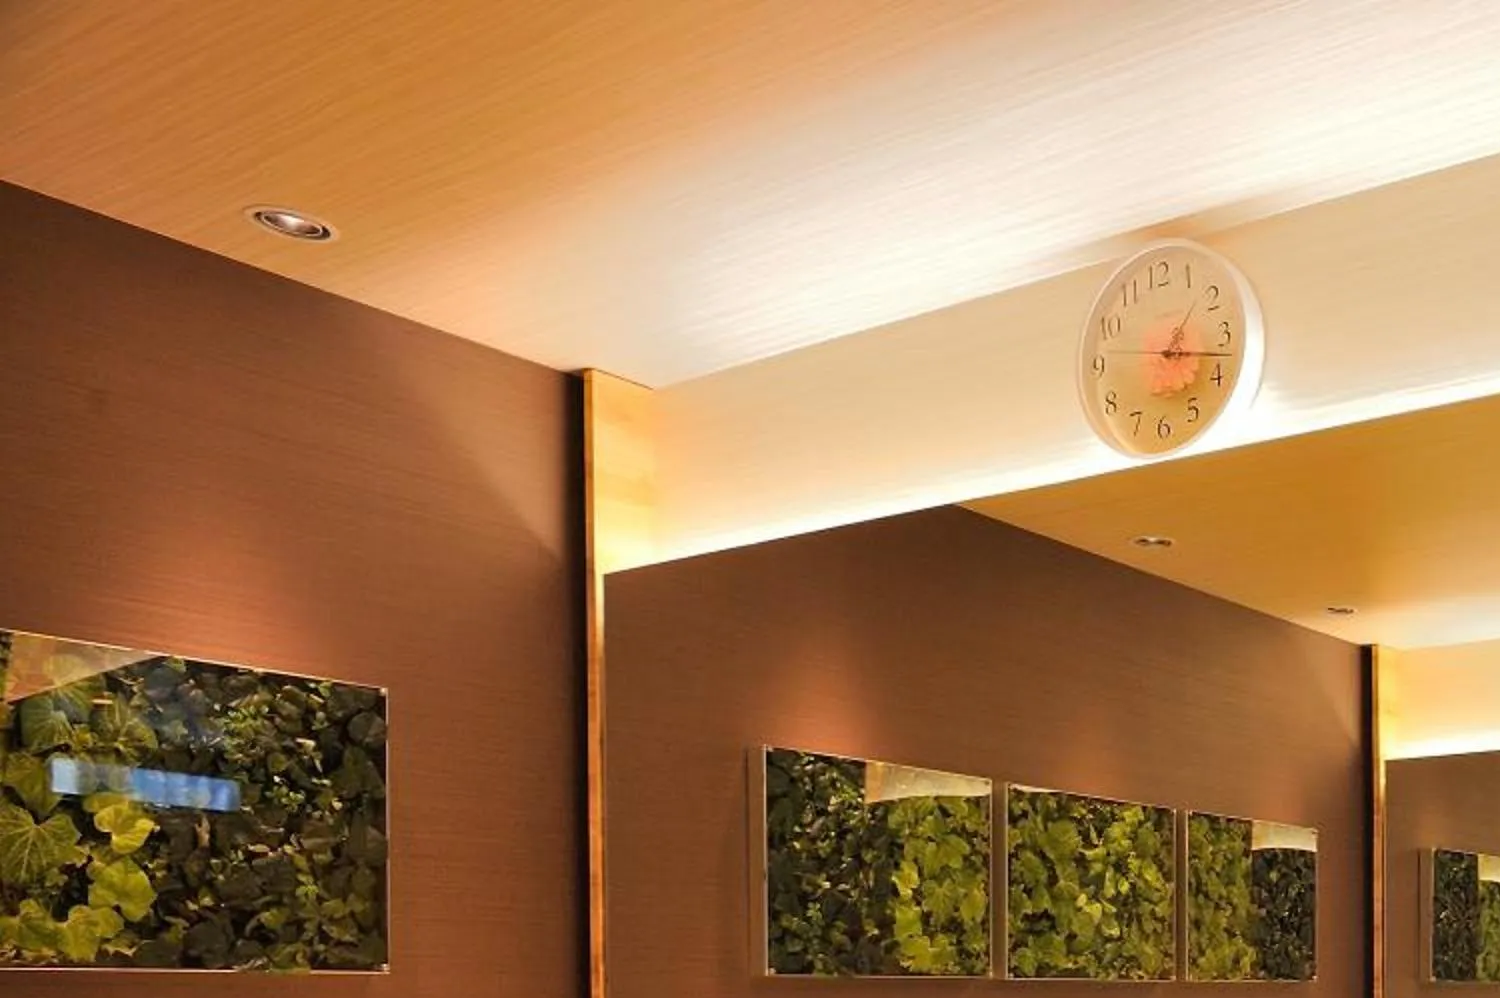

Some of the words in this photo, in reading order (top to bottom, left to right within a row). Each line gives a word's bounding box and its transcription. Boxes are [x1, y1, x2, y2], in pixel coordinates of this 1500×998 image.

[1147, 261, 1169, 290] 12
[1184, 264, 1191, 289] 1
[1121, 279, 1138, 307] 11
[1204, 285, 1221, 311] 2
[1100, 315, 1121, 341] 10
[1217, 321, 1231, 347] 3
[1091, 355, 1105, 379] 9
[1209, 363, 1223, 387] 4
[1105, 391, 1118, 416] 8
[1187, 398, 1200, 423] 5
[1129, 410, 1143, 437] 7
[1157, 415, 1171, 439] 6
